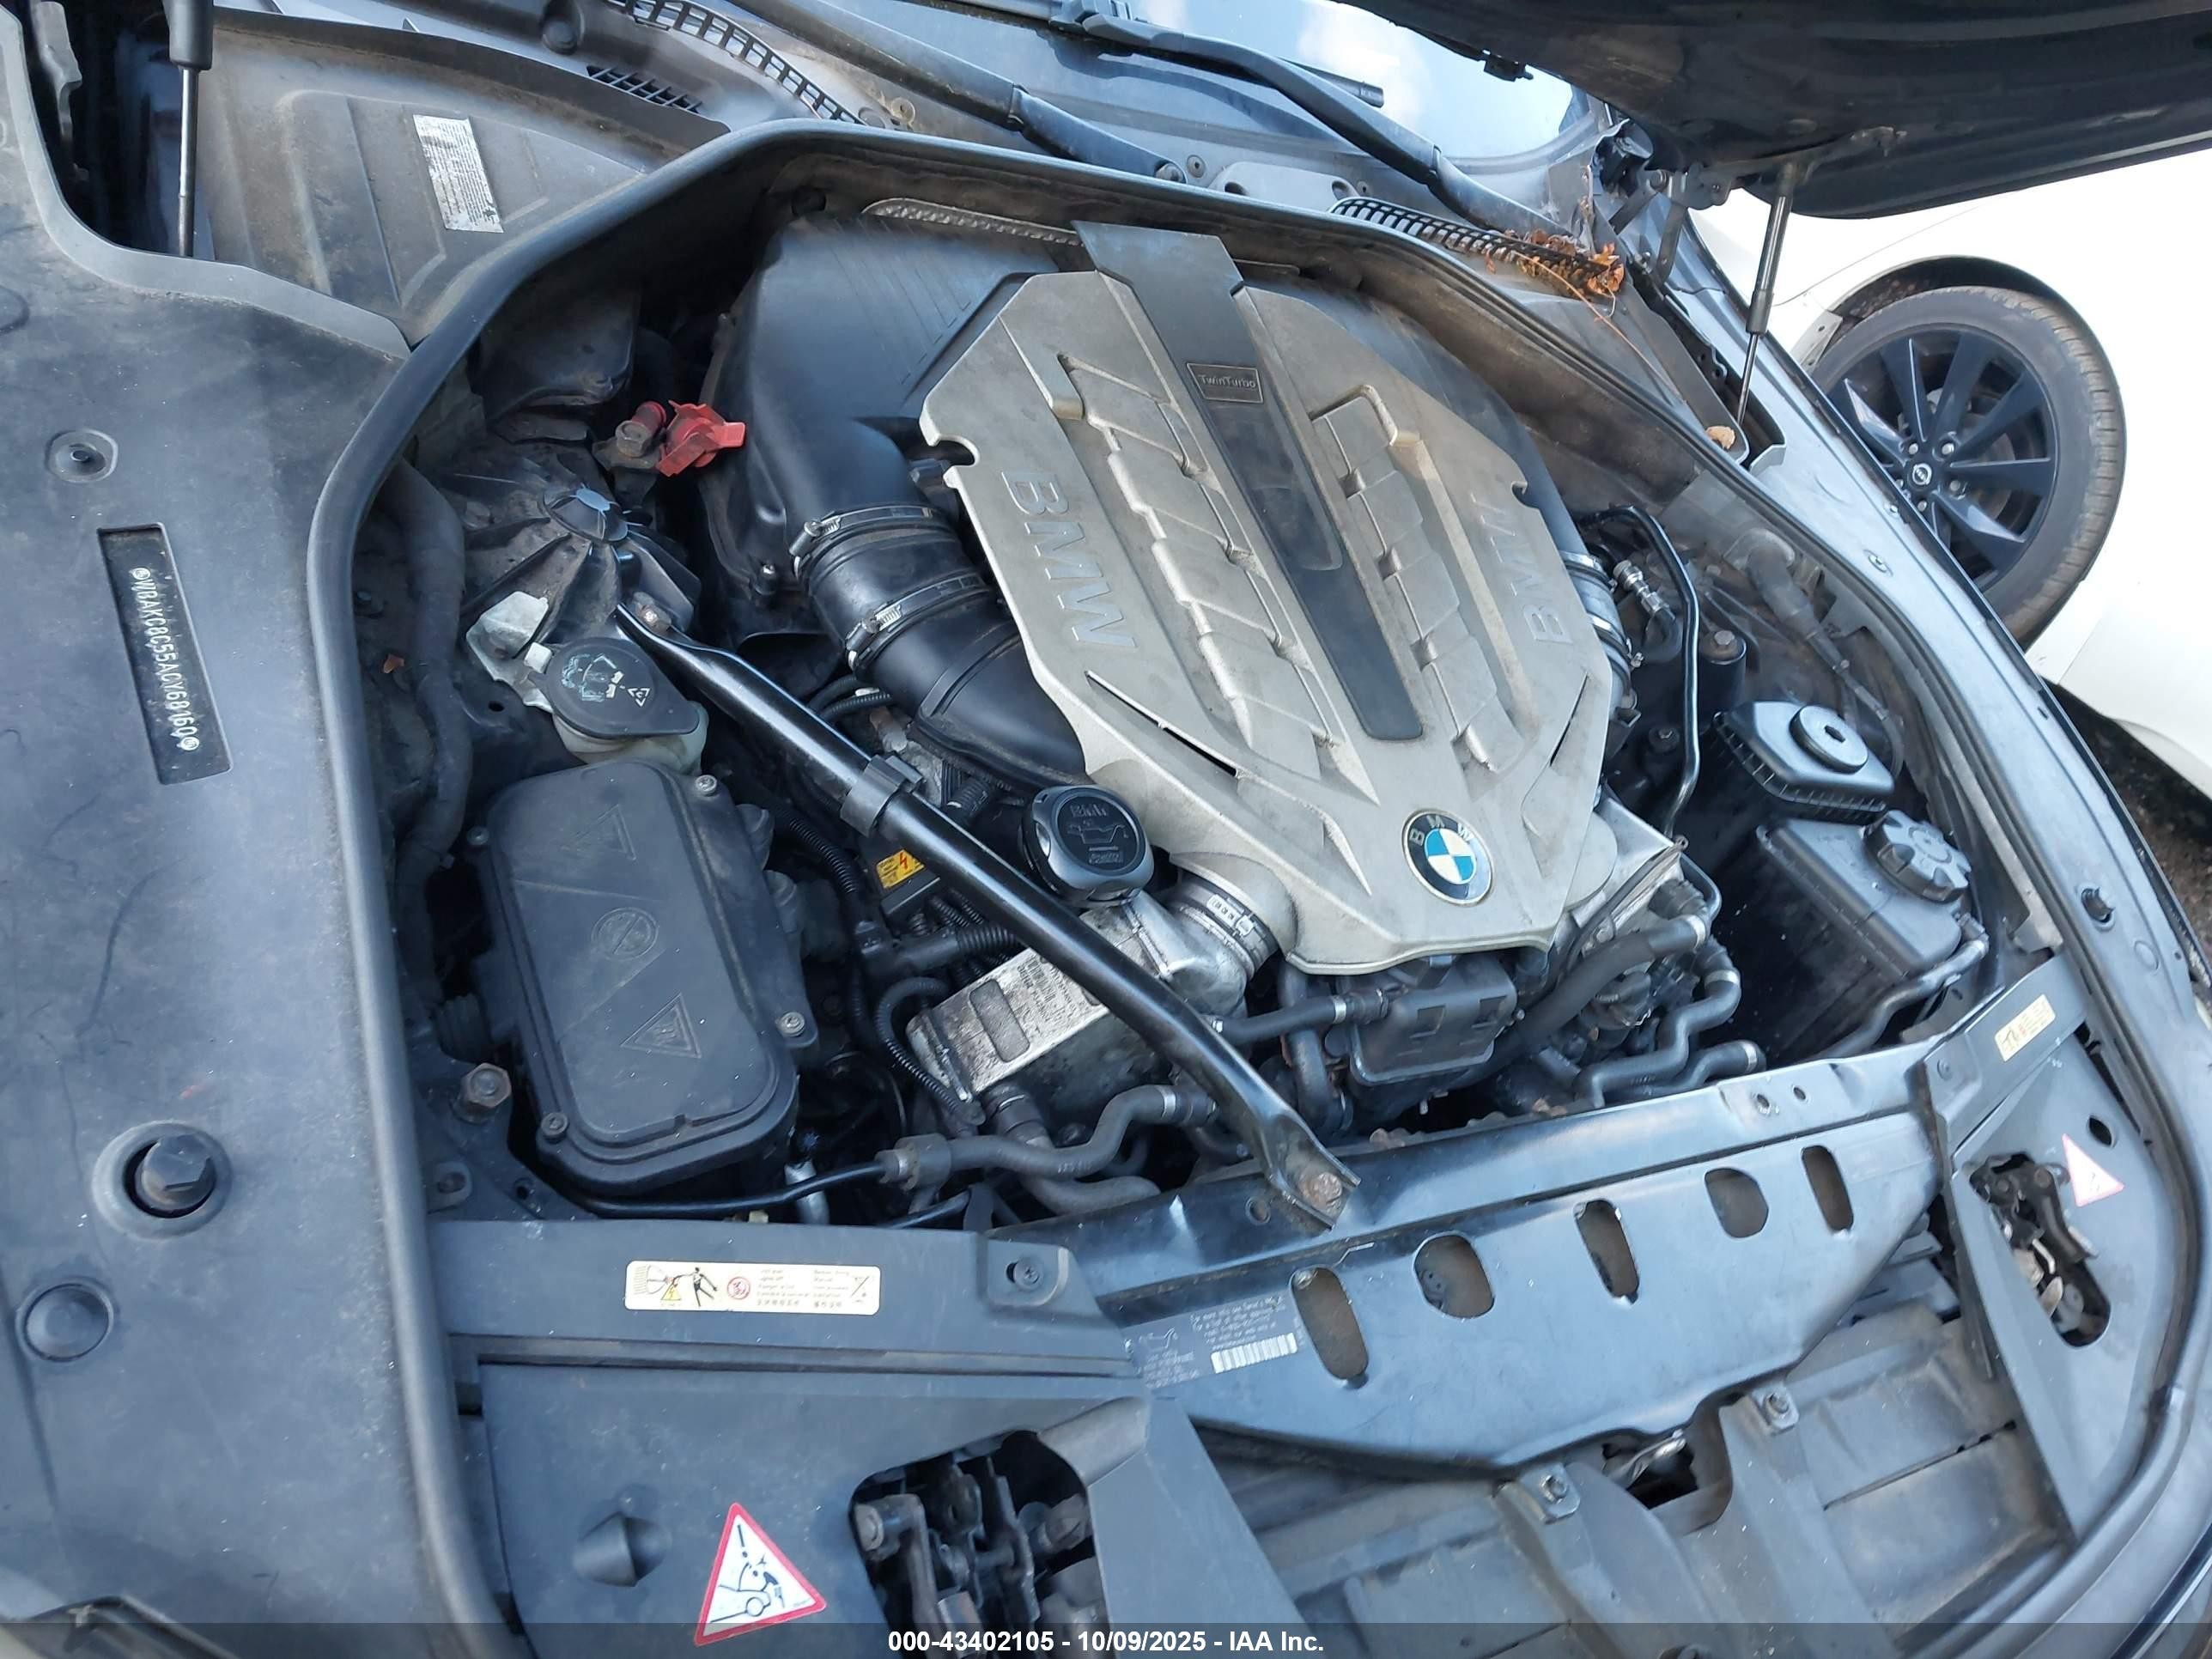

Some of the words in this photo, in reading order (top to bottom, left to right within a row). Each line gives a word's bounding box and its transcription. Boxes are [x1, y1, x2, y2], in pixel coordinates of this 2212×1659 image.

[1198, 374, 1256, 388] TwinTurbo
[1001, 471, 1138, 647] BMW
[1470, 493, 1573, 645] BMW
[133, 578, 198, 738] WBAKC8C55ACY68160
[1409, 814, 1476, 847] BMW
